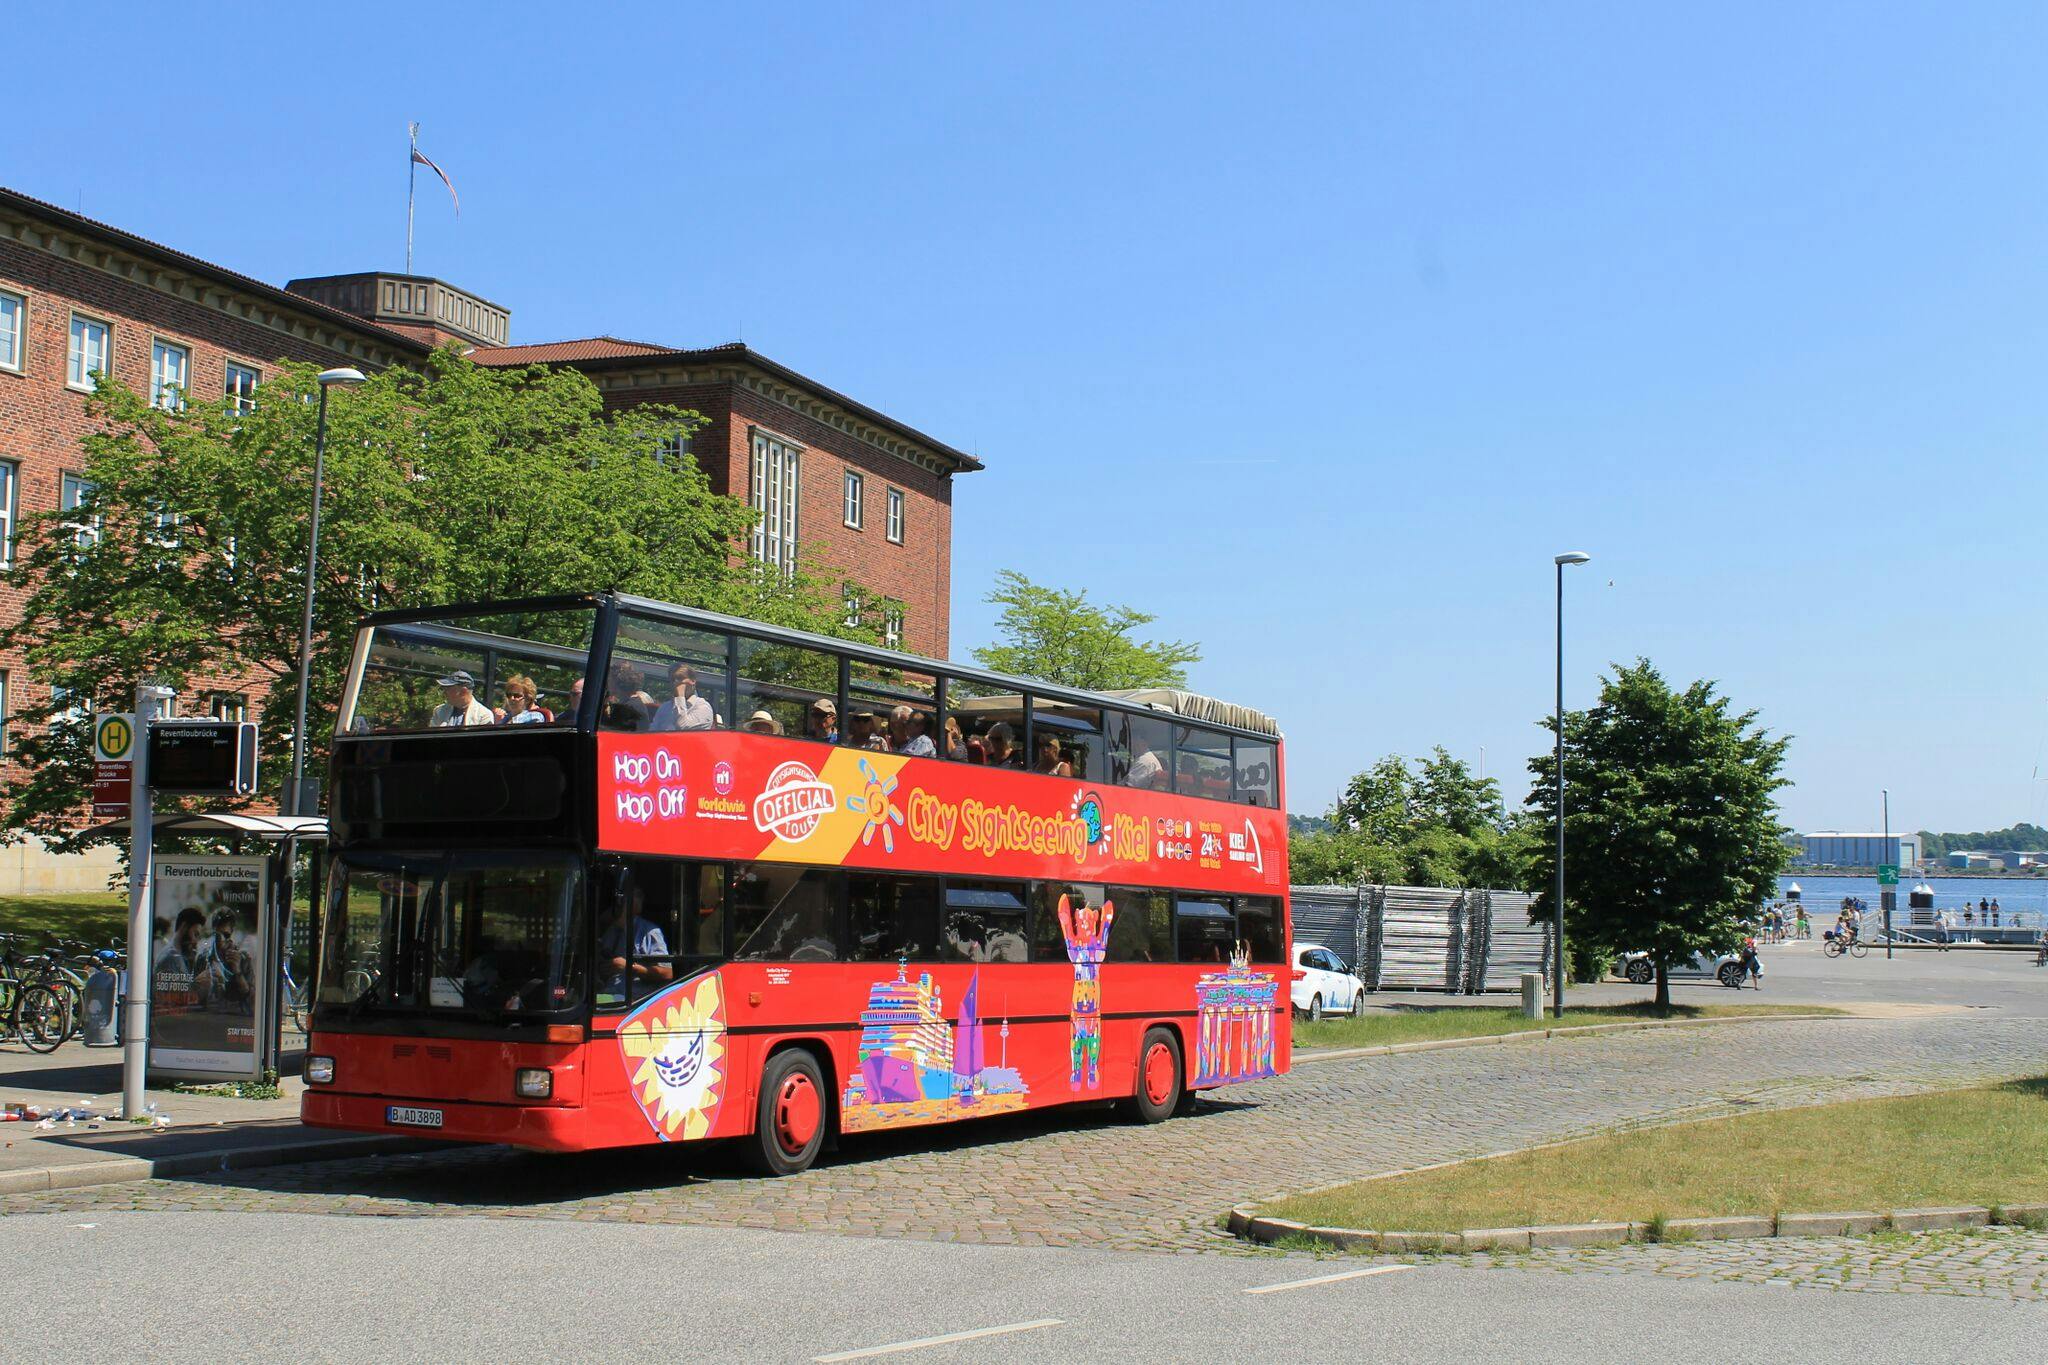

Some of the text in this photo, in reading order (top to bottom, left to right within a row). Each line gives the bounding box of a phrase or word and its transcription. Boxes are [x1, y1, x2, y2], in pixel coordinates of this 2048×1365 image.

[107, 726, 121, 750] H
[160, 728, 218, 738] Reventloubrücke
[614, 750, 681, 784] Hop On
[617, 788, 686, 822] Hop Off
[763, 789, 831, 822] OFFICIAL
[785, 815, 816, 836] TOUR
[907, 787, 1149, 864] City Sightseeing Kiel
[1201, 833, 1214, 856] 24
[1229, 832, 1245, 850] KIEL
[165, 865, 251, 878] Reventloubrücke
[156, 982, 189, 992] 500 FOTOS
[161, 972, 195, 983] REPORTAGE
[227, 1027, 256, 1037] STAY TRUE
[391, 1106, 442, 1125] B AD 3898
